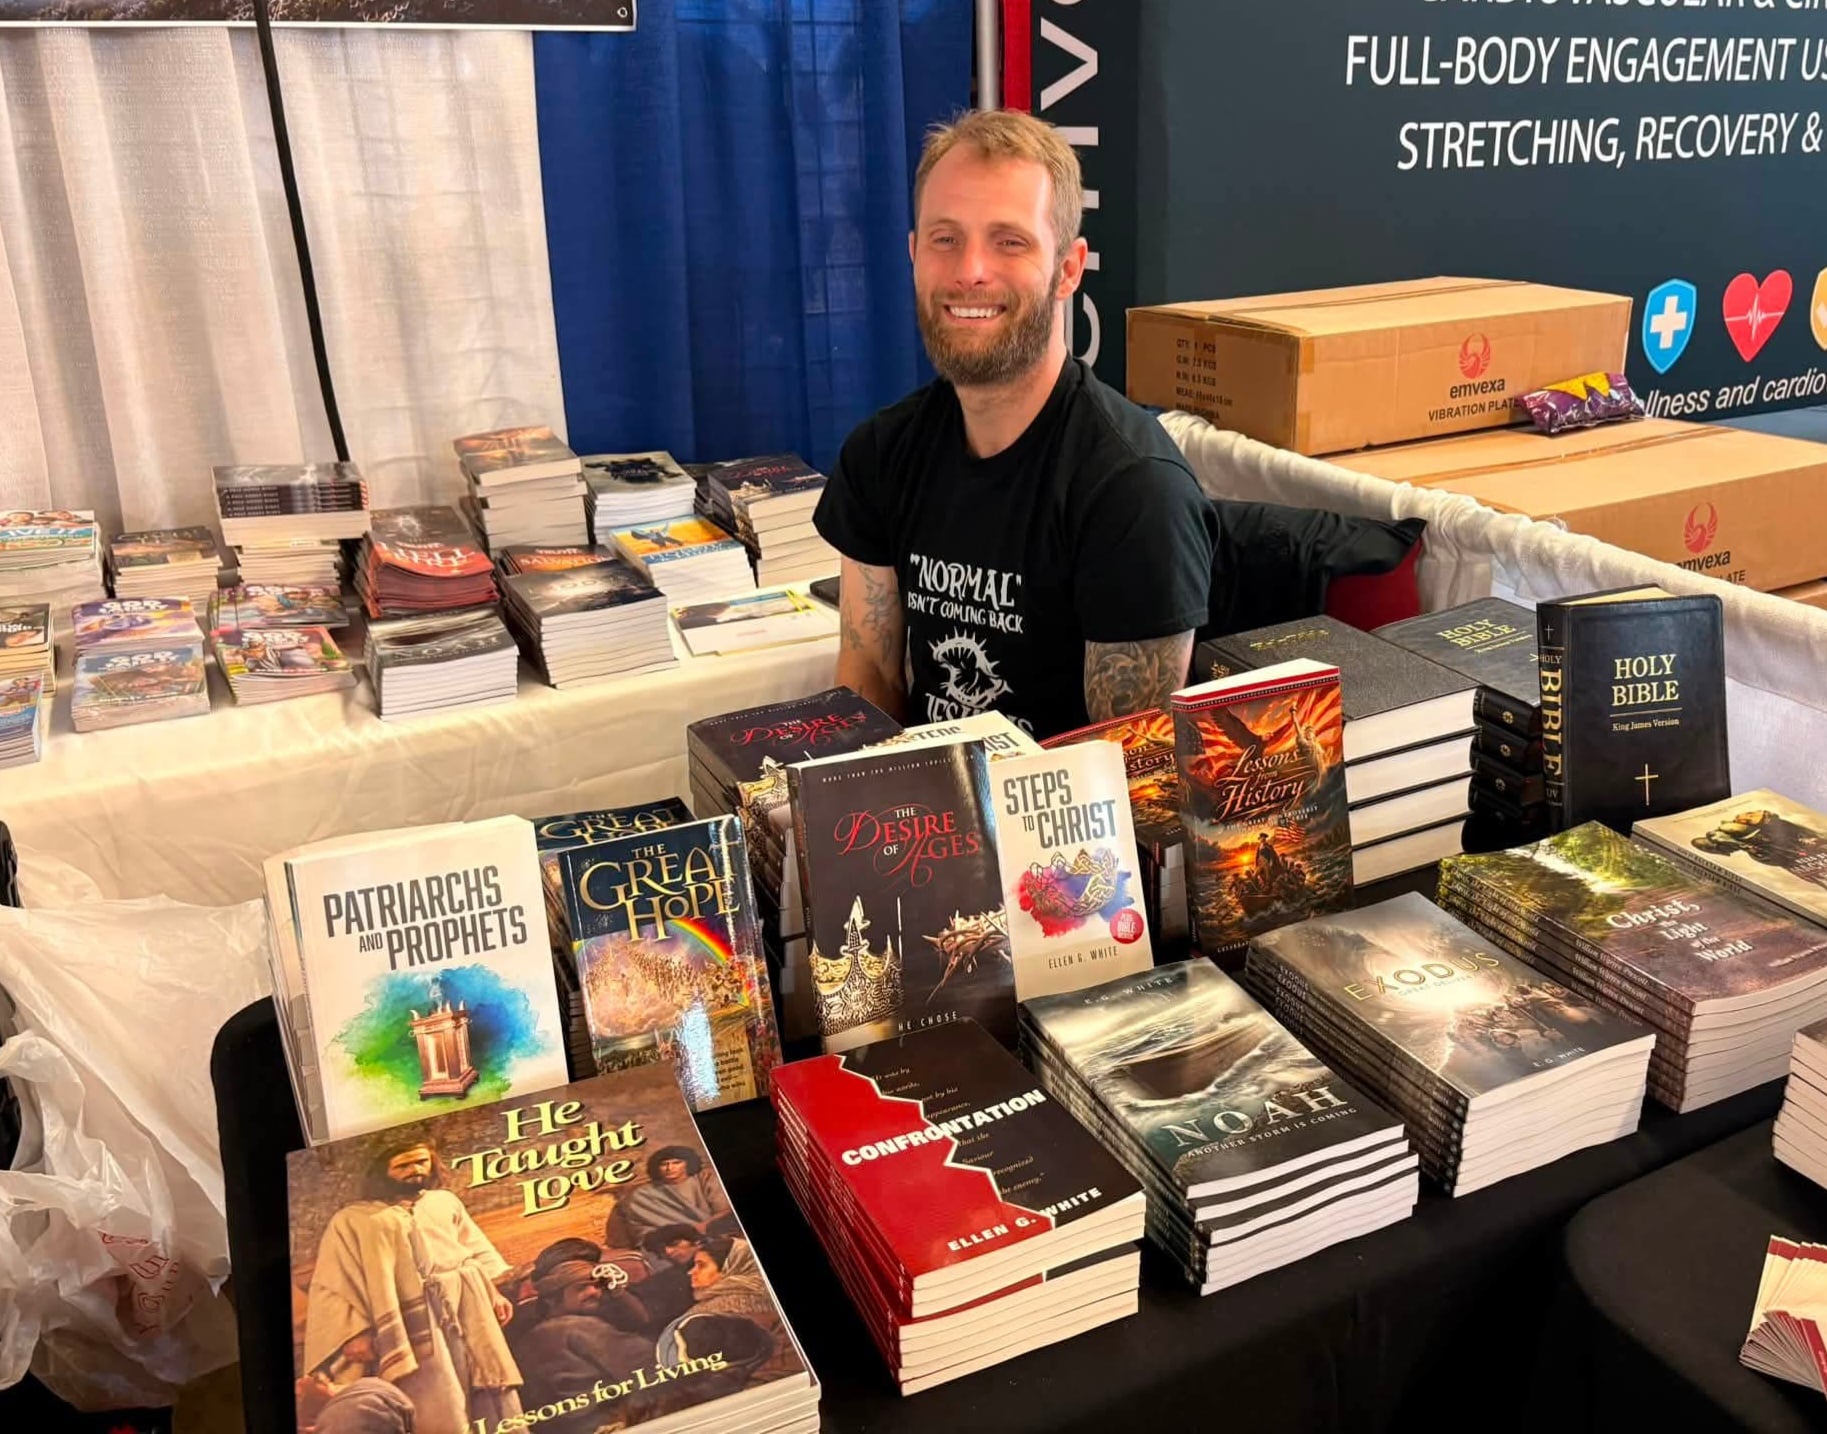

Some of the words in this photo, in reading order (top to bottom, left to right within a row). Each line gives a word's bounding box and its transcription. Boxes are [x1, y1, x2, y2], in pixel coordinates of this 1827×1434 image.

[1345, 35, 1560, 86] FULL-BODY
[1566, 37, 1797, 84] ENGAGEMENT
[1397, 117, 1626, 171] STRETCHING,
[1635, 112, 1800, 161] RECOVERY
[1801, 111, 1823, 153] &
[1450, 378, 1506, 399] emvexa
[1645, 389, 1711, 418] llness
[1715, 375, 1761, 410] and
[1428, 400, 1486, 422] VIBRATION
[910, 553, 1022, 611] "NORMAL"
[1725, 569, 1747, 584] ATE
[908, 591, 940, 615] ISN'T
[940, 601, 986, 626] COMING
[989, 611, 1024, 635] BACK
[1436, 619, 1496, 640] HOLY
[1450, 624, 1517, 647] BIBLE
[1614, 653, 1677, 680] HOLY
[1611, 680, 1680, 707] BIBLE
[984, 731, 1020, 752] IST
[1540, 668, 1562, 777] BIBLE
[1612, 721, 1629, 732] King
[1630, 720, 1651, 731] James
[1653, 717, 1680, 728] Version
[1215, 744, 1302, 787] Lessons
[894, 807, 917, 818] THE
[1003, 769, 1073, 816] STEPS
[1214, 778, 1305, 823] History
[834, 809, 958, 856] DESIRE
[1022, 814, 1035, 832] TO
[1038, 799, 1118, 849] CHRIST
[631, 843, 666, 859] THE
[873, 830, 981, 888] AGES
[883, 844, 899, 857] OF
[579, 842, 741, 911] GREAT
[323, 865, 503, 938] PATRIARCHS
[620, 879, 741, 943] HOPE
[1605, 898, 1701, 930] Christ,
[359, 931, 384, 953] AND
[386, 905, 528, 970] PROPHETS
[1659, 921, 1709, 941] Light
[1694, 940, 1753, 962] World
[1048, 951, 1074, 969] ELLEN
[1090, 946, 1118, 961] WHITE
[1343, 952, 1500, 1001] EXODUS
[1122, 977, 1173, 994] WHITE
[920, 1010, 957, 1027] CHOSE
[1556, 1046, 1585, 1060] WHITE
[501, 1100, 583, 1144] He
[841, 1089, 1048, 1167] CONFRONTATION
[1161, 1086, 1348, 1148] NOAH
[1187, 1138, 1246, 1158] ANOTHER
[1249, 1126, 1291, 1143] STORM
[1294, 1121, 1307, 1130] IS
[1310, 1108, 1358, 1125] COMING
[451, 1119, 643, 1189] Taught
[516, 1159, 635, 1217] Love
[947, 1223, 1009, 1251] ELLEN
[1015, 1216, 1037, 1228] G.
[1039, 1187, 1102, 1218] WHITE
[473, 1390, 591, 1434] Lessons
[592, 1379, 634, 1403] for
[633, 1351, 728, 1390] Living
